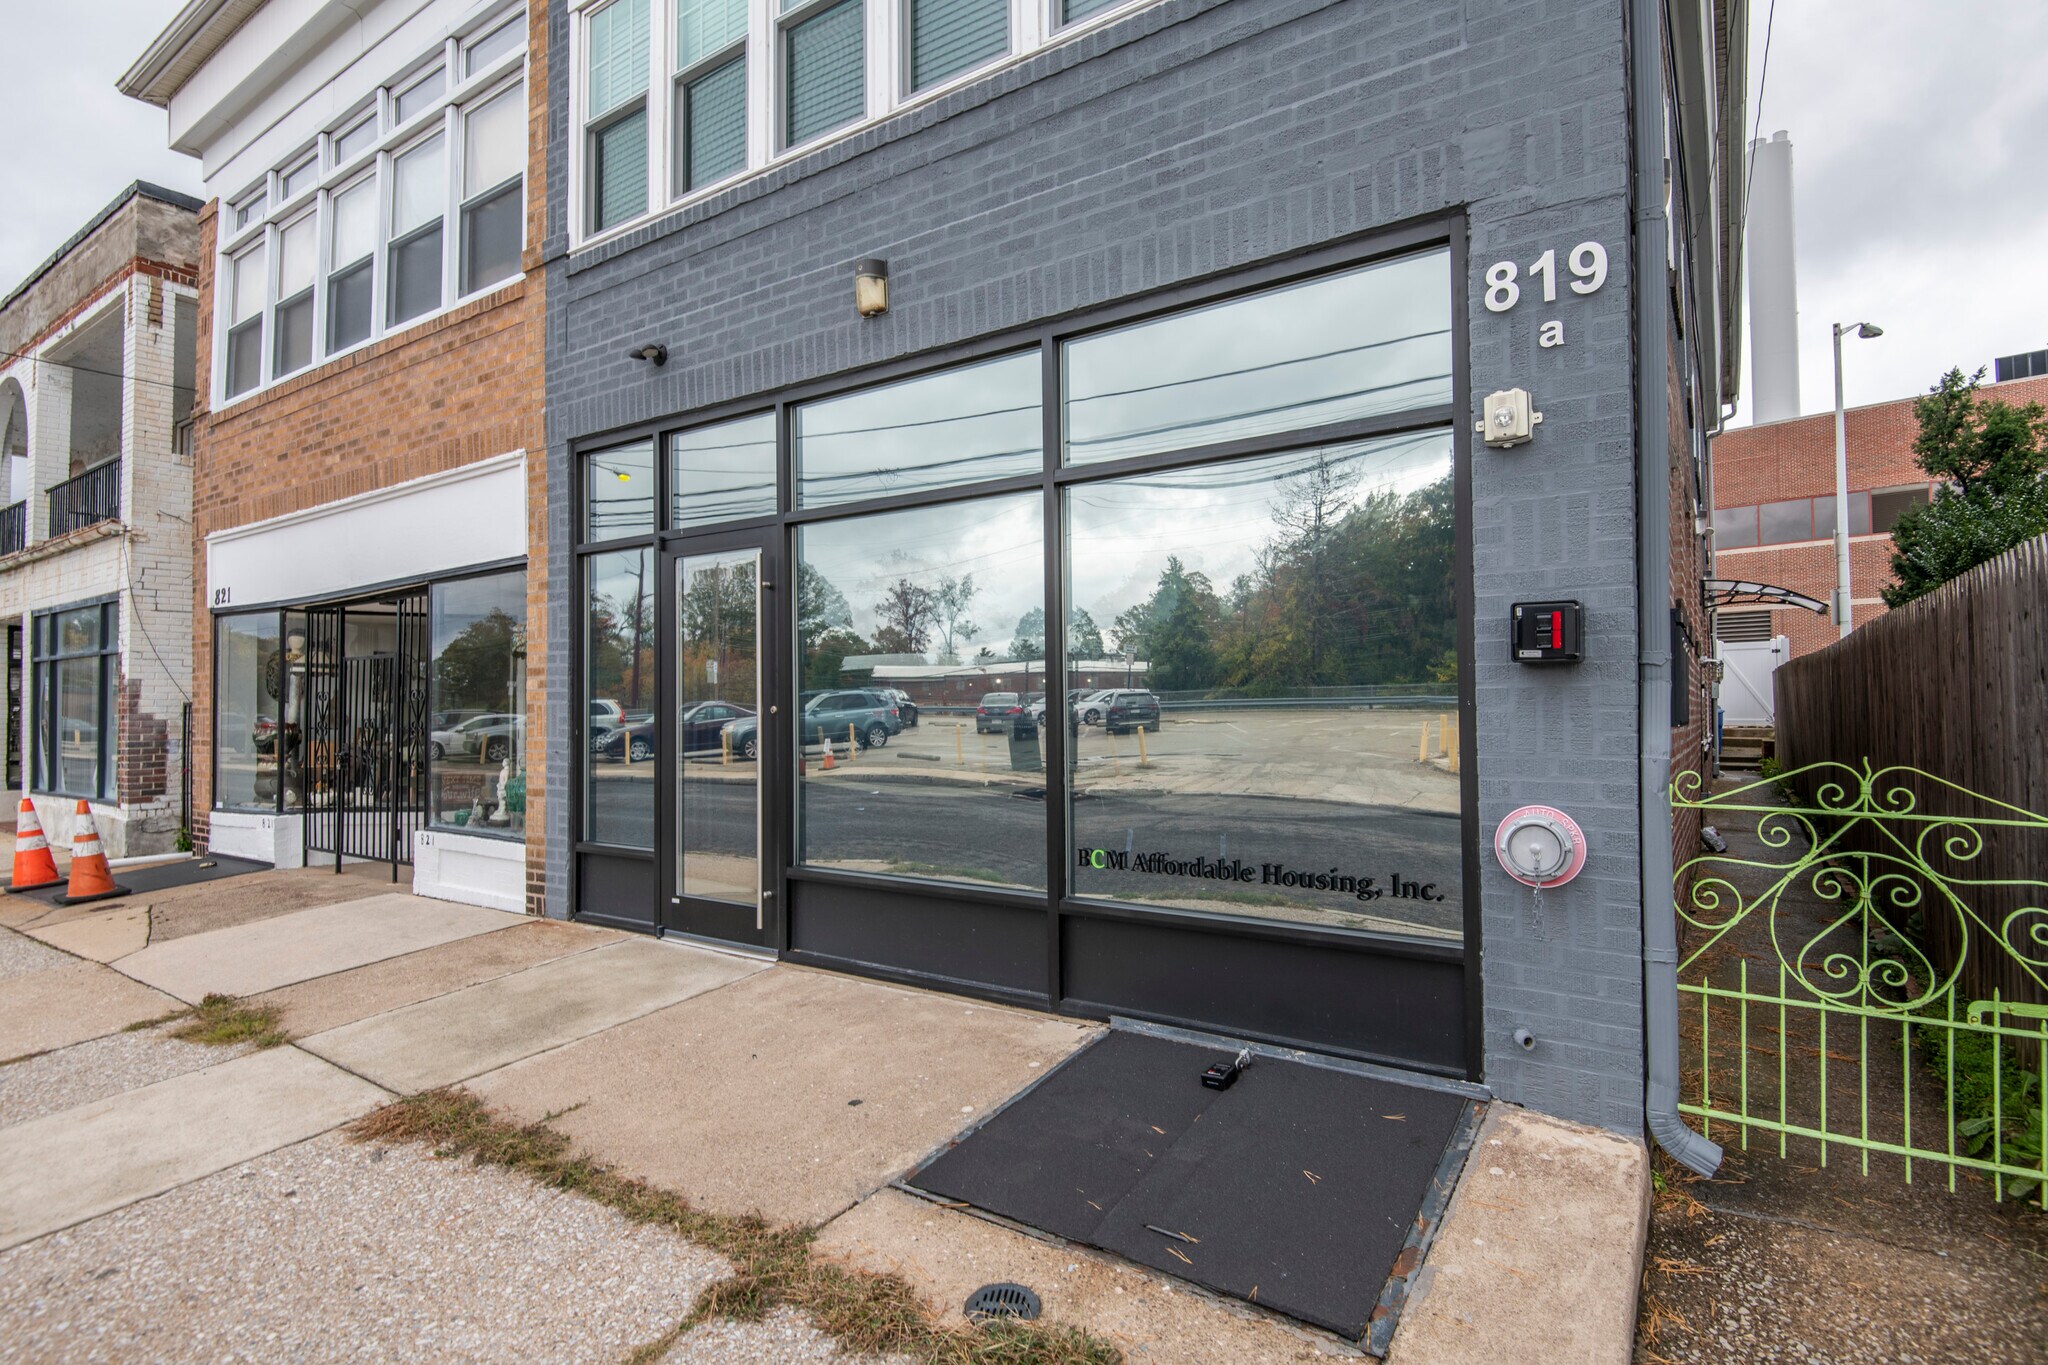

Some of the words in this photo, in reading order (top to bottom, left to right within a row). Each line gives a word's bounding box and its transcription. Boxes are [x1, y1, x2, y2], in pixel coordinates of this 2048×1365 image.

[1484, 241, 1608, 312] 819
[1539, 320, 1565, 347] a
[214, 586, 231, 605] 821
[420, 833, 435, 846] 821
[1525, 808, 1554, 818] AUTO
[1562, 819, 1581, 845] SPKR
[1078, 848, 1126, 871] BCM
[1131, 852, 1256, 883] Affordable
[1261, 862, 1383, 901] Housing,
[1390, 873, 1445, 902] Inc.
